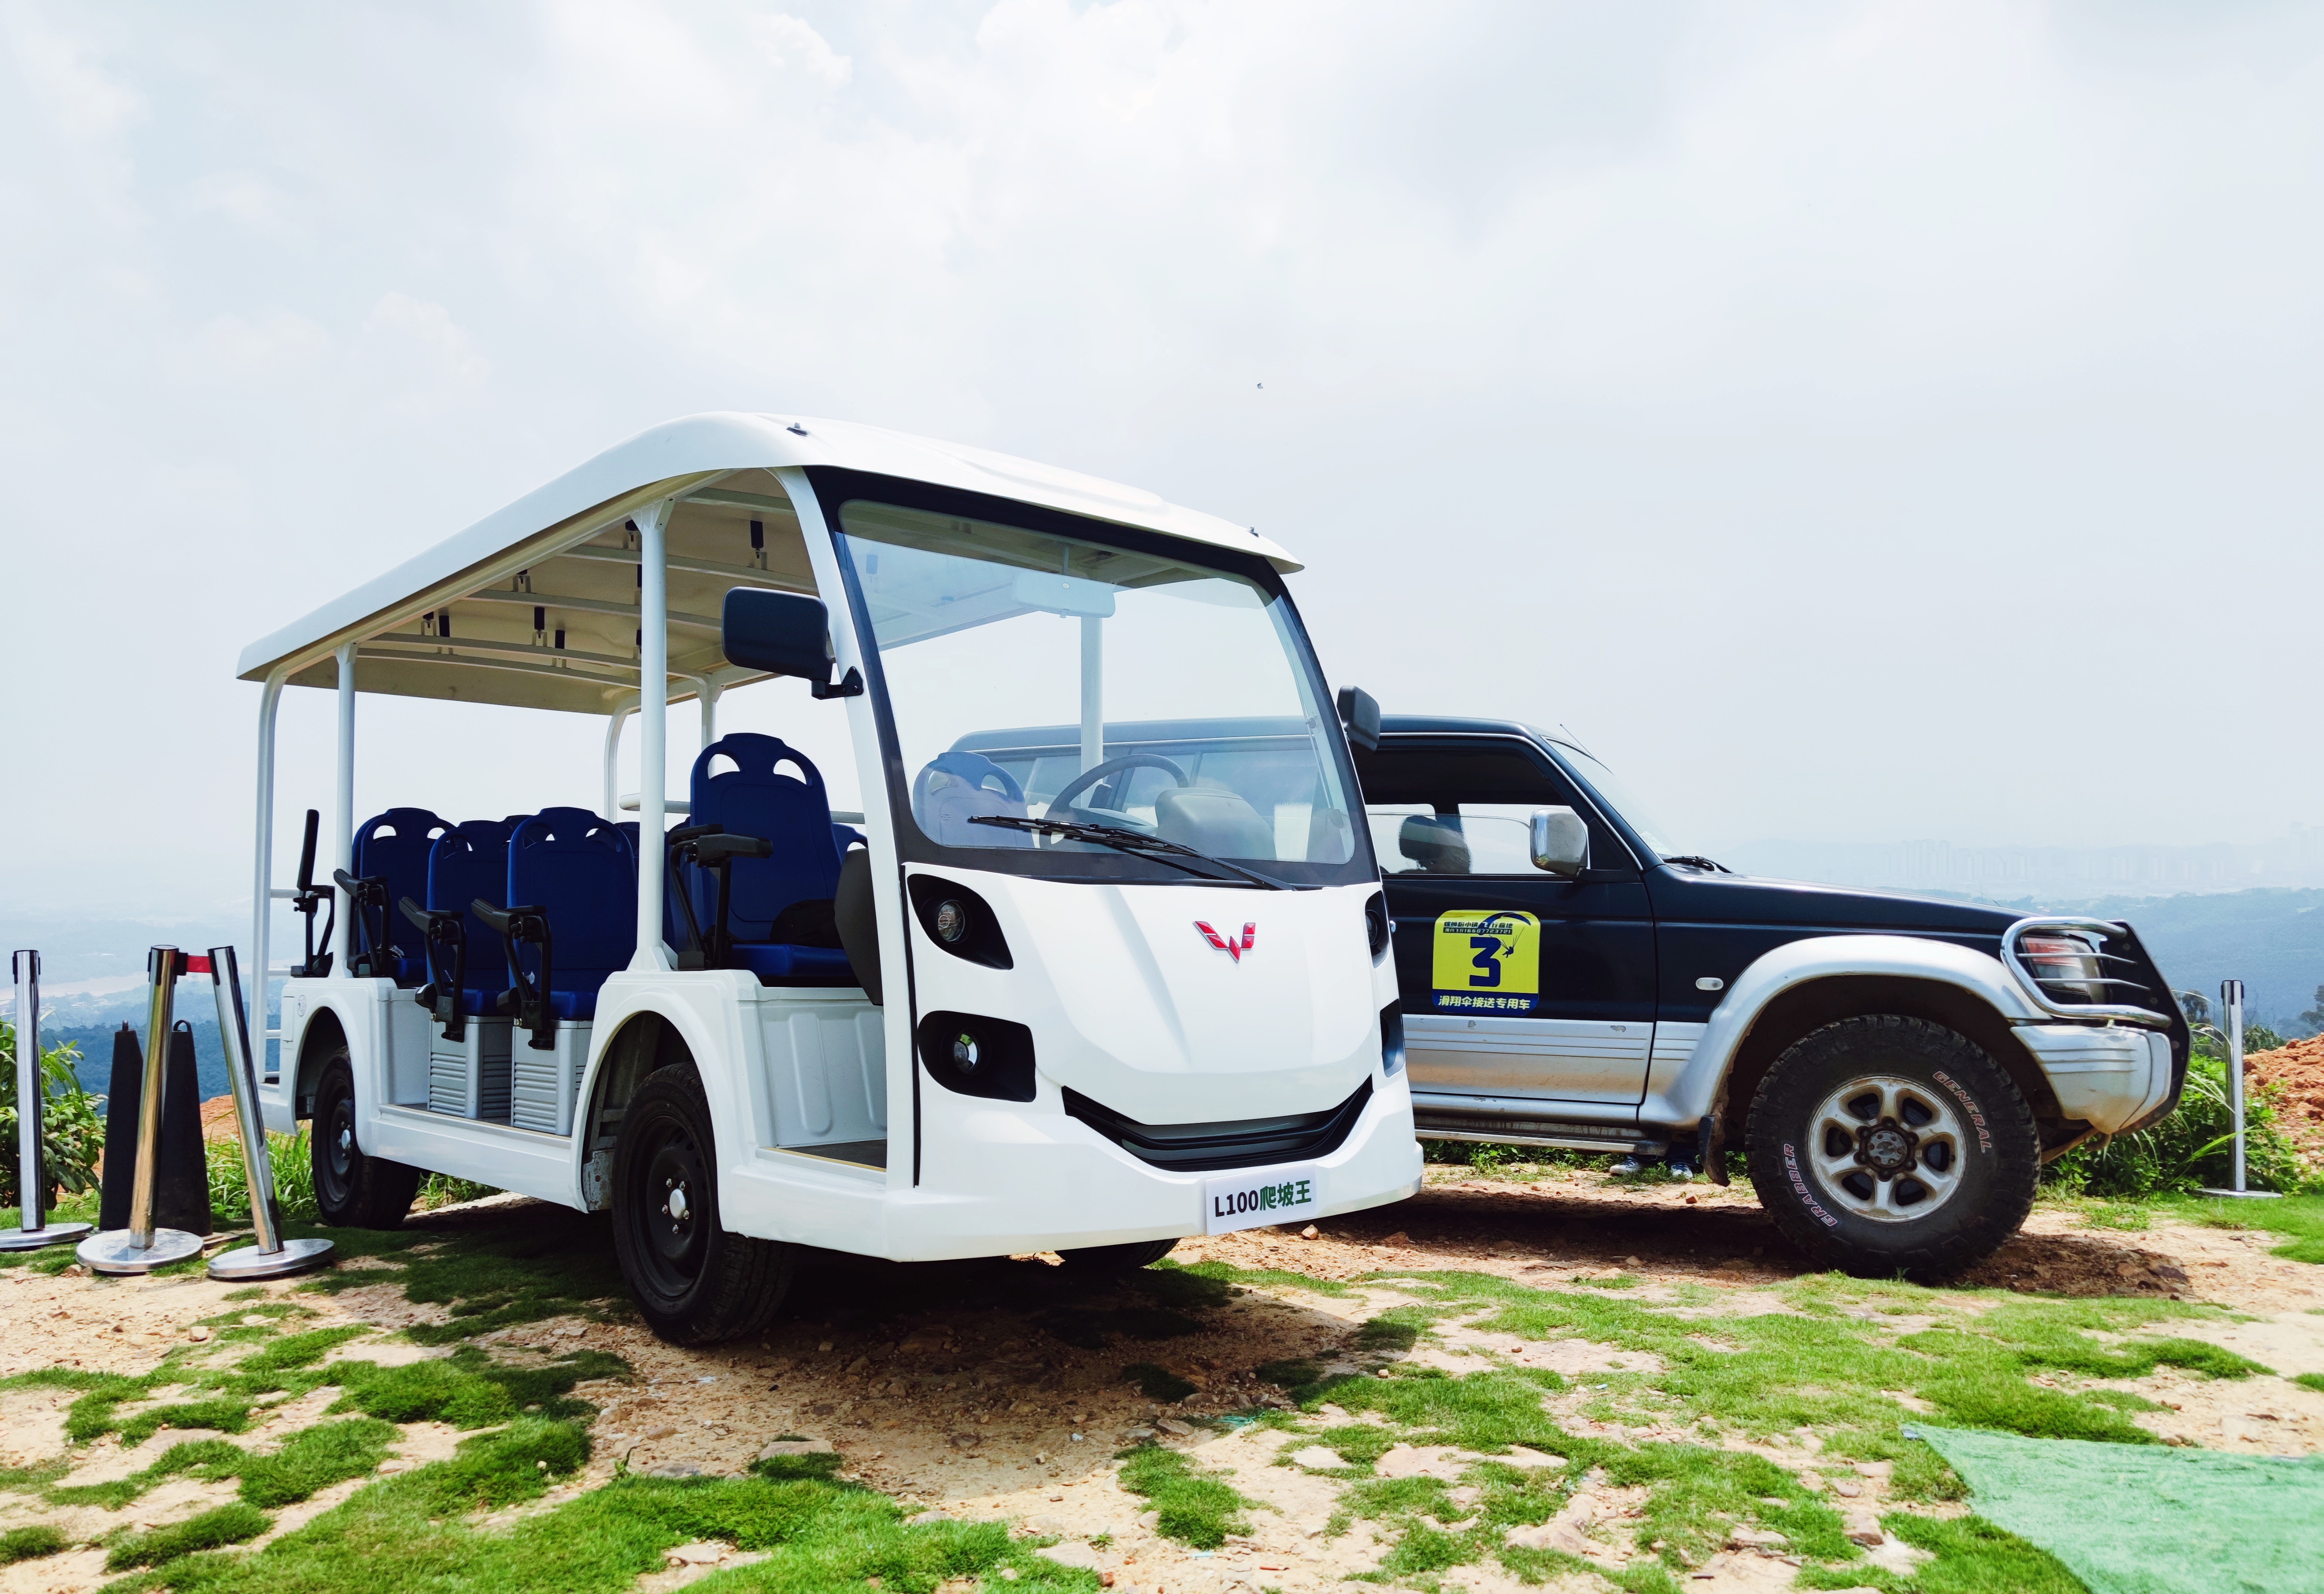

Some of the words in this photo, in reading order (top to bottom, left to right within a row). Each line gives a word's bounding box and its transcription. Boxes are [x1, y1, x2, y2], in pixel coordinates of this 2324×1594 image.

[1469, 937, 1501, 987] 3
[1438, 995, 1531, 1010] 滑翔伞接送专用车
[1932, 1071, 1992, 1153] GENERAL
[1215, 1180, 1312, 1217] L100爬坡王
[1784, 1143, 1838, 1227] GRABBER
